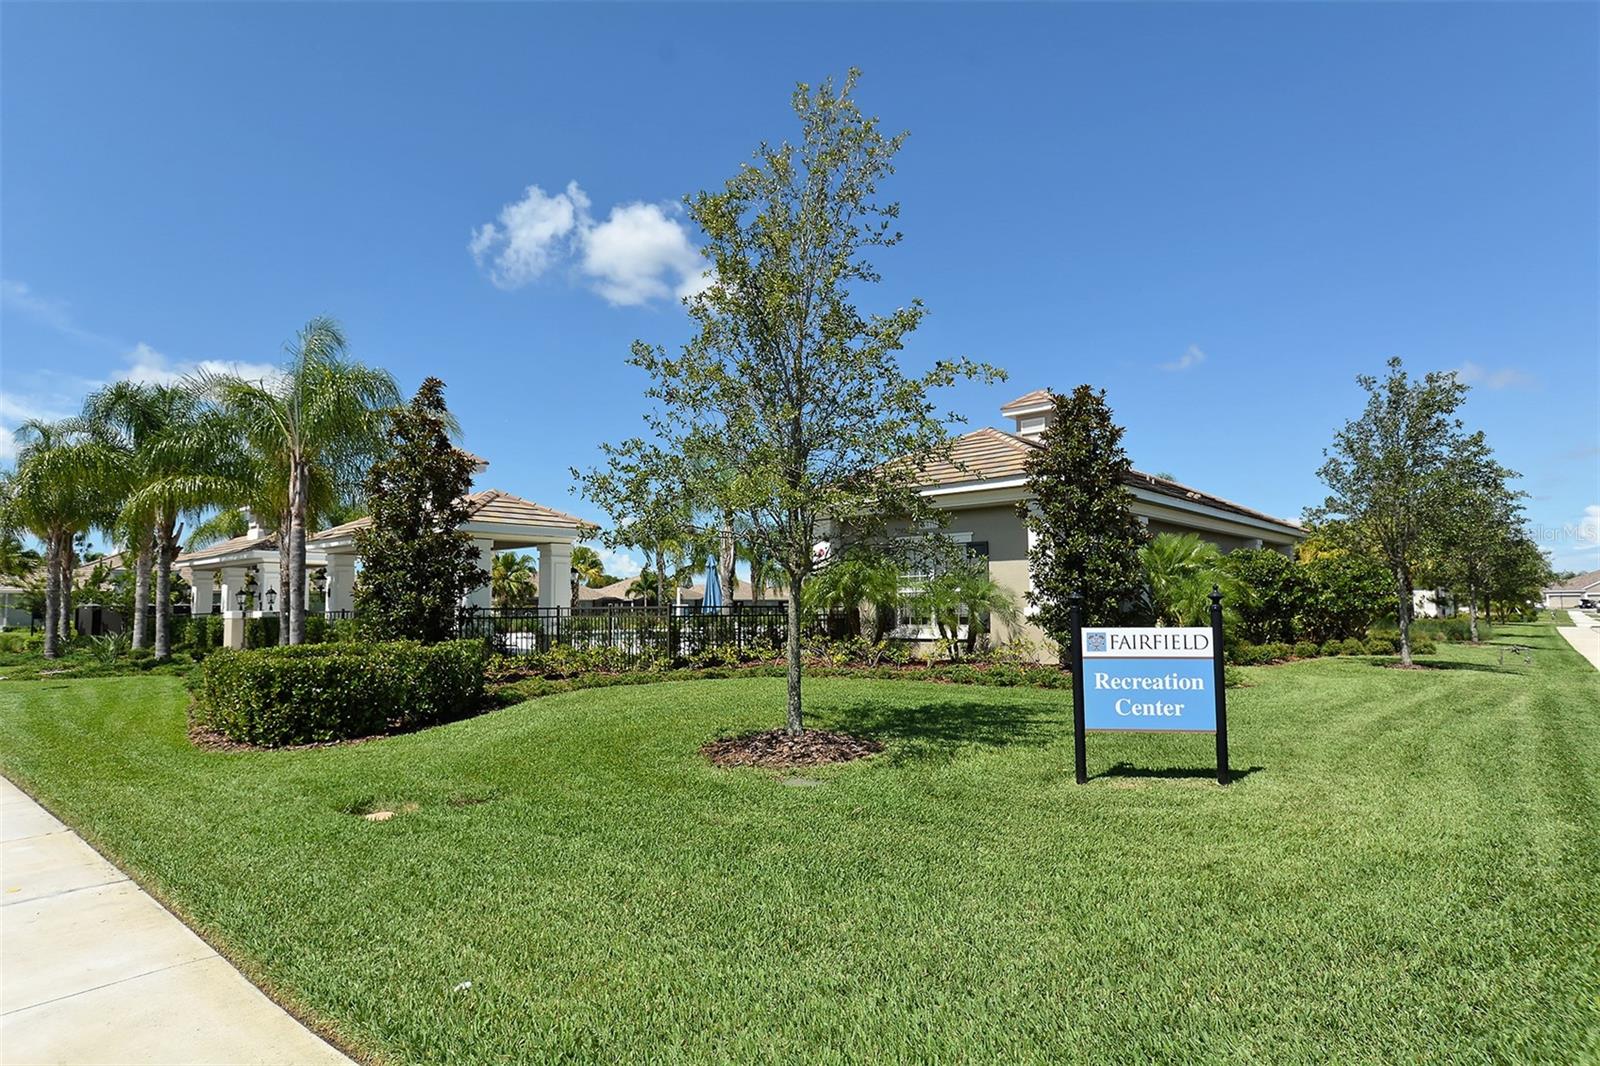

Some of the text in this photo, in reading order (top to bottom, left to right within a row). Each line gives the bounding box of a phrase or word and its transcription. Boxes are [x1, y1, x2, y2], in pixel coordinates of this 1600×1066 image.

[1110, 634, 1209, 650] FAIRFIELD
[1094, 672, 1204, 691] Recreation
[1115, 698, 1185, 717] Center
